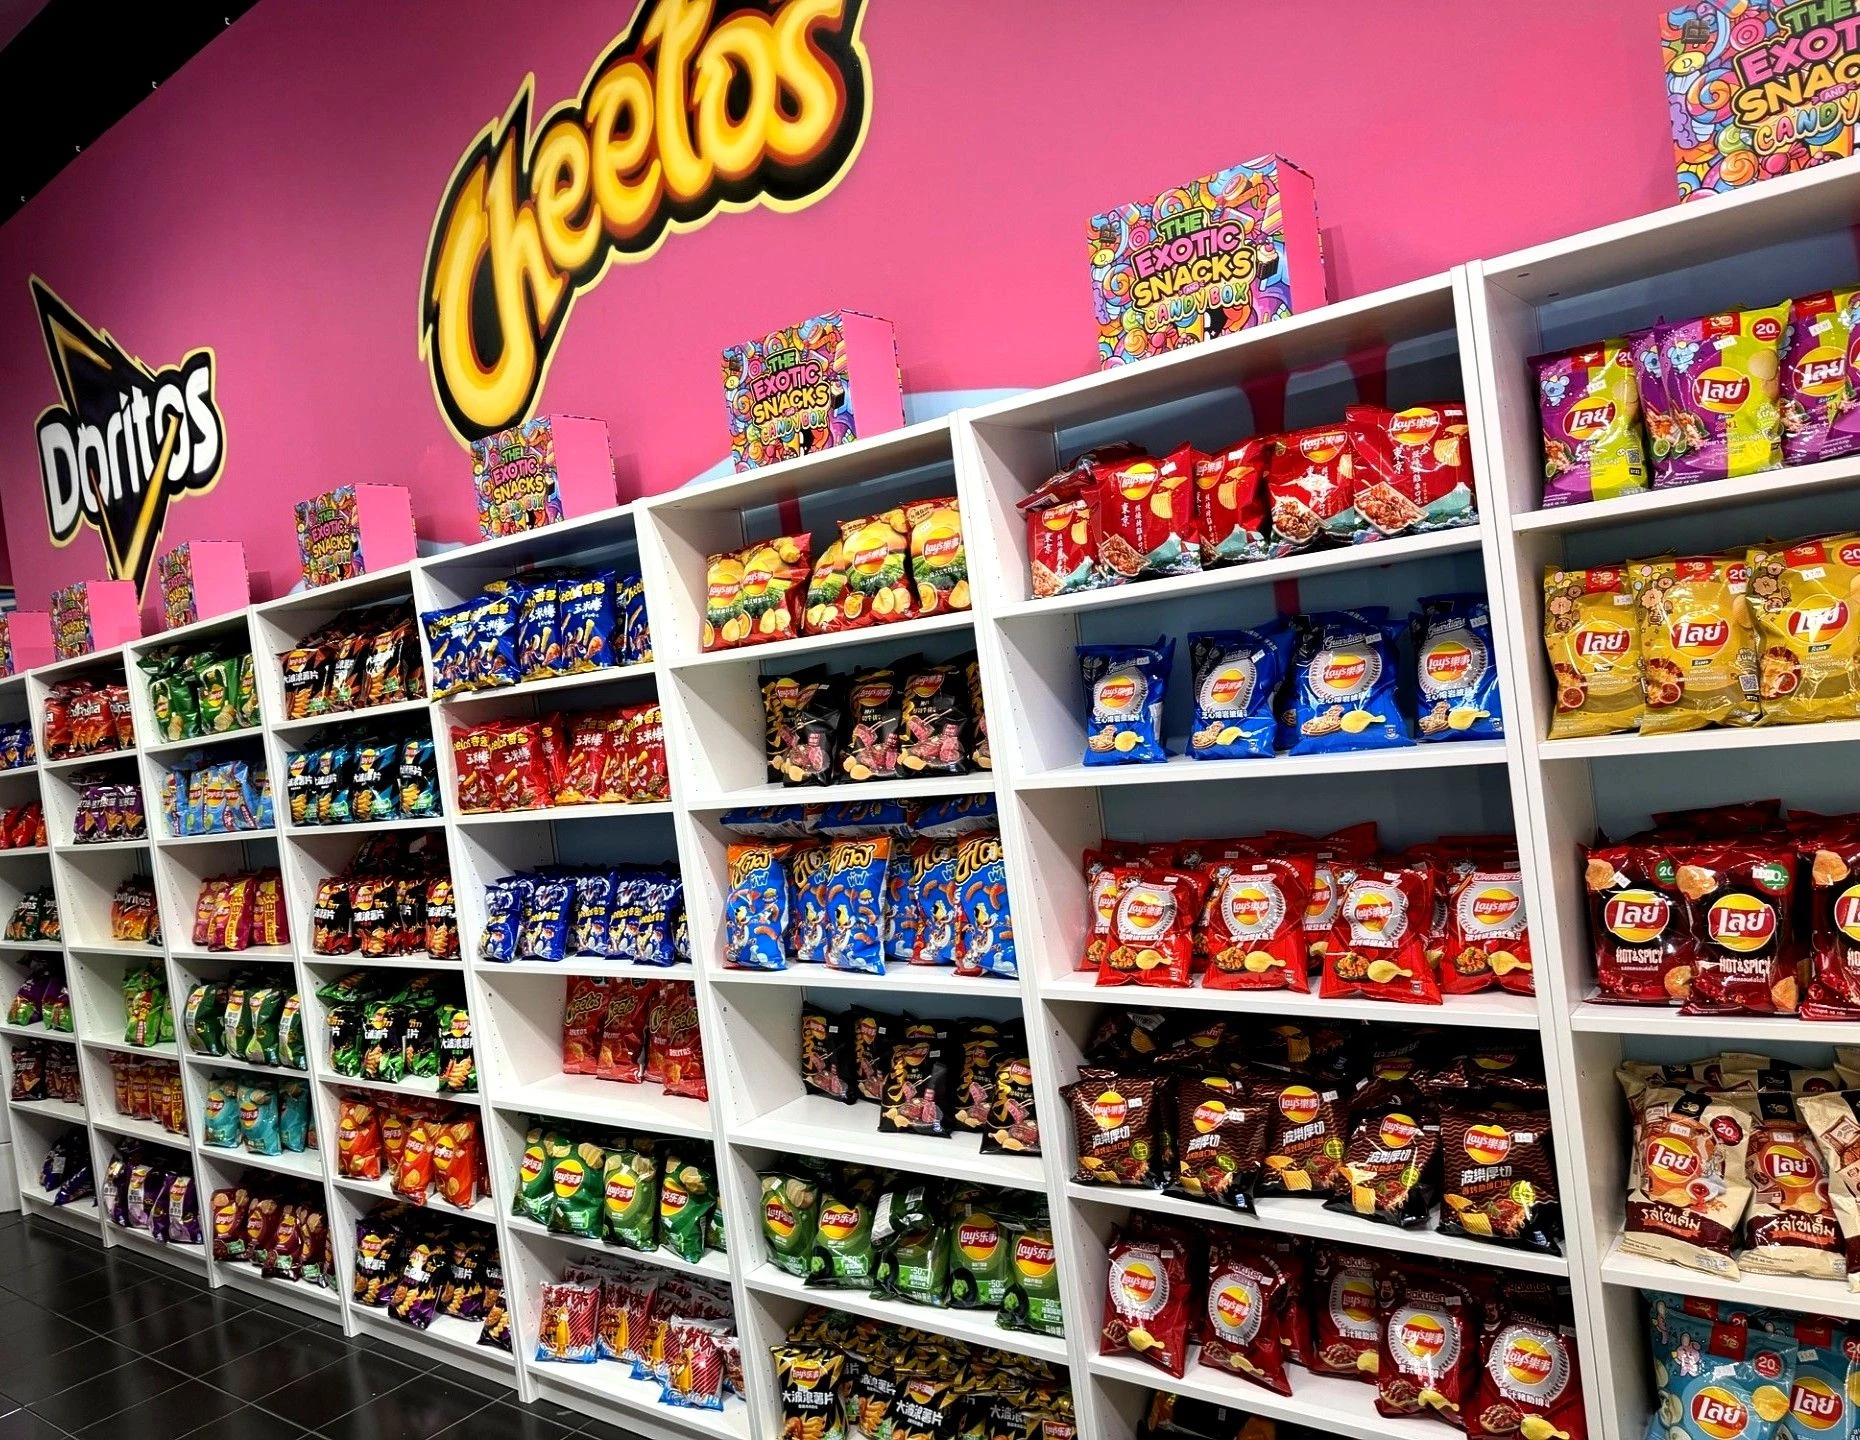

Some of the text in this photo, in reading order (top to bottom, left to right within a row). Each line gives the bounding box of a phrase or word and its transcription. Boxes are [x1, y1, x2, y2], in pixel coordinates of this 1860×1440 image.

[1756, 91, 1857, 152] CANDY
[424, 0, 866, 430] Cheetos
[1160, 211, 1204, 240] THE
[1134, 223, 1242, 279] EXOTIC
[1133, 250, 1255, 304] SNACKS
[1144, 282, 1250, 331] CANDY BOX
[767, 350, 797, 376] THE
[752, 363, 820, 402] EXOTIC
[1700, 377, 1744, 403] เลย์
[752, 384, 829, 424] SNACKS
[801, 410, 826, 427] BOX
[38, 356, 222, 538] Doritos
[502, 447, 522, 463] THE
[492, 457, 537, 486] EXOTIC
[1393, 446, 1405, 475] 東京
[493, 474, 545, 506] SNACKS
[1120, 502, 1131, 528] 東京
[310, 519, 346, 543] EXOTIC
[311, 533, 351, 559] SNACKS
[1324, 633, 1366, 651] Guardians
[1582, 628, 1624, 656] เลย์
[1678, 619, 1722, 648] เลย์
[1324, 663, 1365, 679] Lay's樂事
[1428, 653, 1470, 670] Lay's樂事
[1613, 899, 1661, 928] เลย์
[1717, 906, 1766, 937] เลย์
[1616, 946, 1663, 964] HOT&SPICY
[1719, 956, 1771, 975] HOT&SPICY
[1281, 1096, 1318, 1111] Lay's樂事
[1282, 1121, 1326, 1147] 波樂厚切
[1466, 1131, 1509, 1151] Lay's樂事
[1652, 1144, 1693, 1171] เลย์
[1772, 1152, 1808, 1178] เลย์
[1460, 1165, 1512, 1187] 波樂厚切
[1227, 1259, 1264, 1280] Rakuten
[1405, 1288, 1447, 1303] Rakuten
[782, 1390, 834, 1405] 大波浪薯片
[1697, 1395, 1741, 1425] เลย์
[1793, 1387, 1836, 1416] เลย์
[896, 1399, 943, 1426] 大波浪薯片
